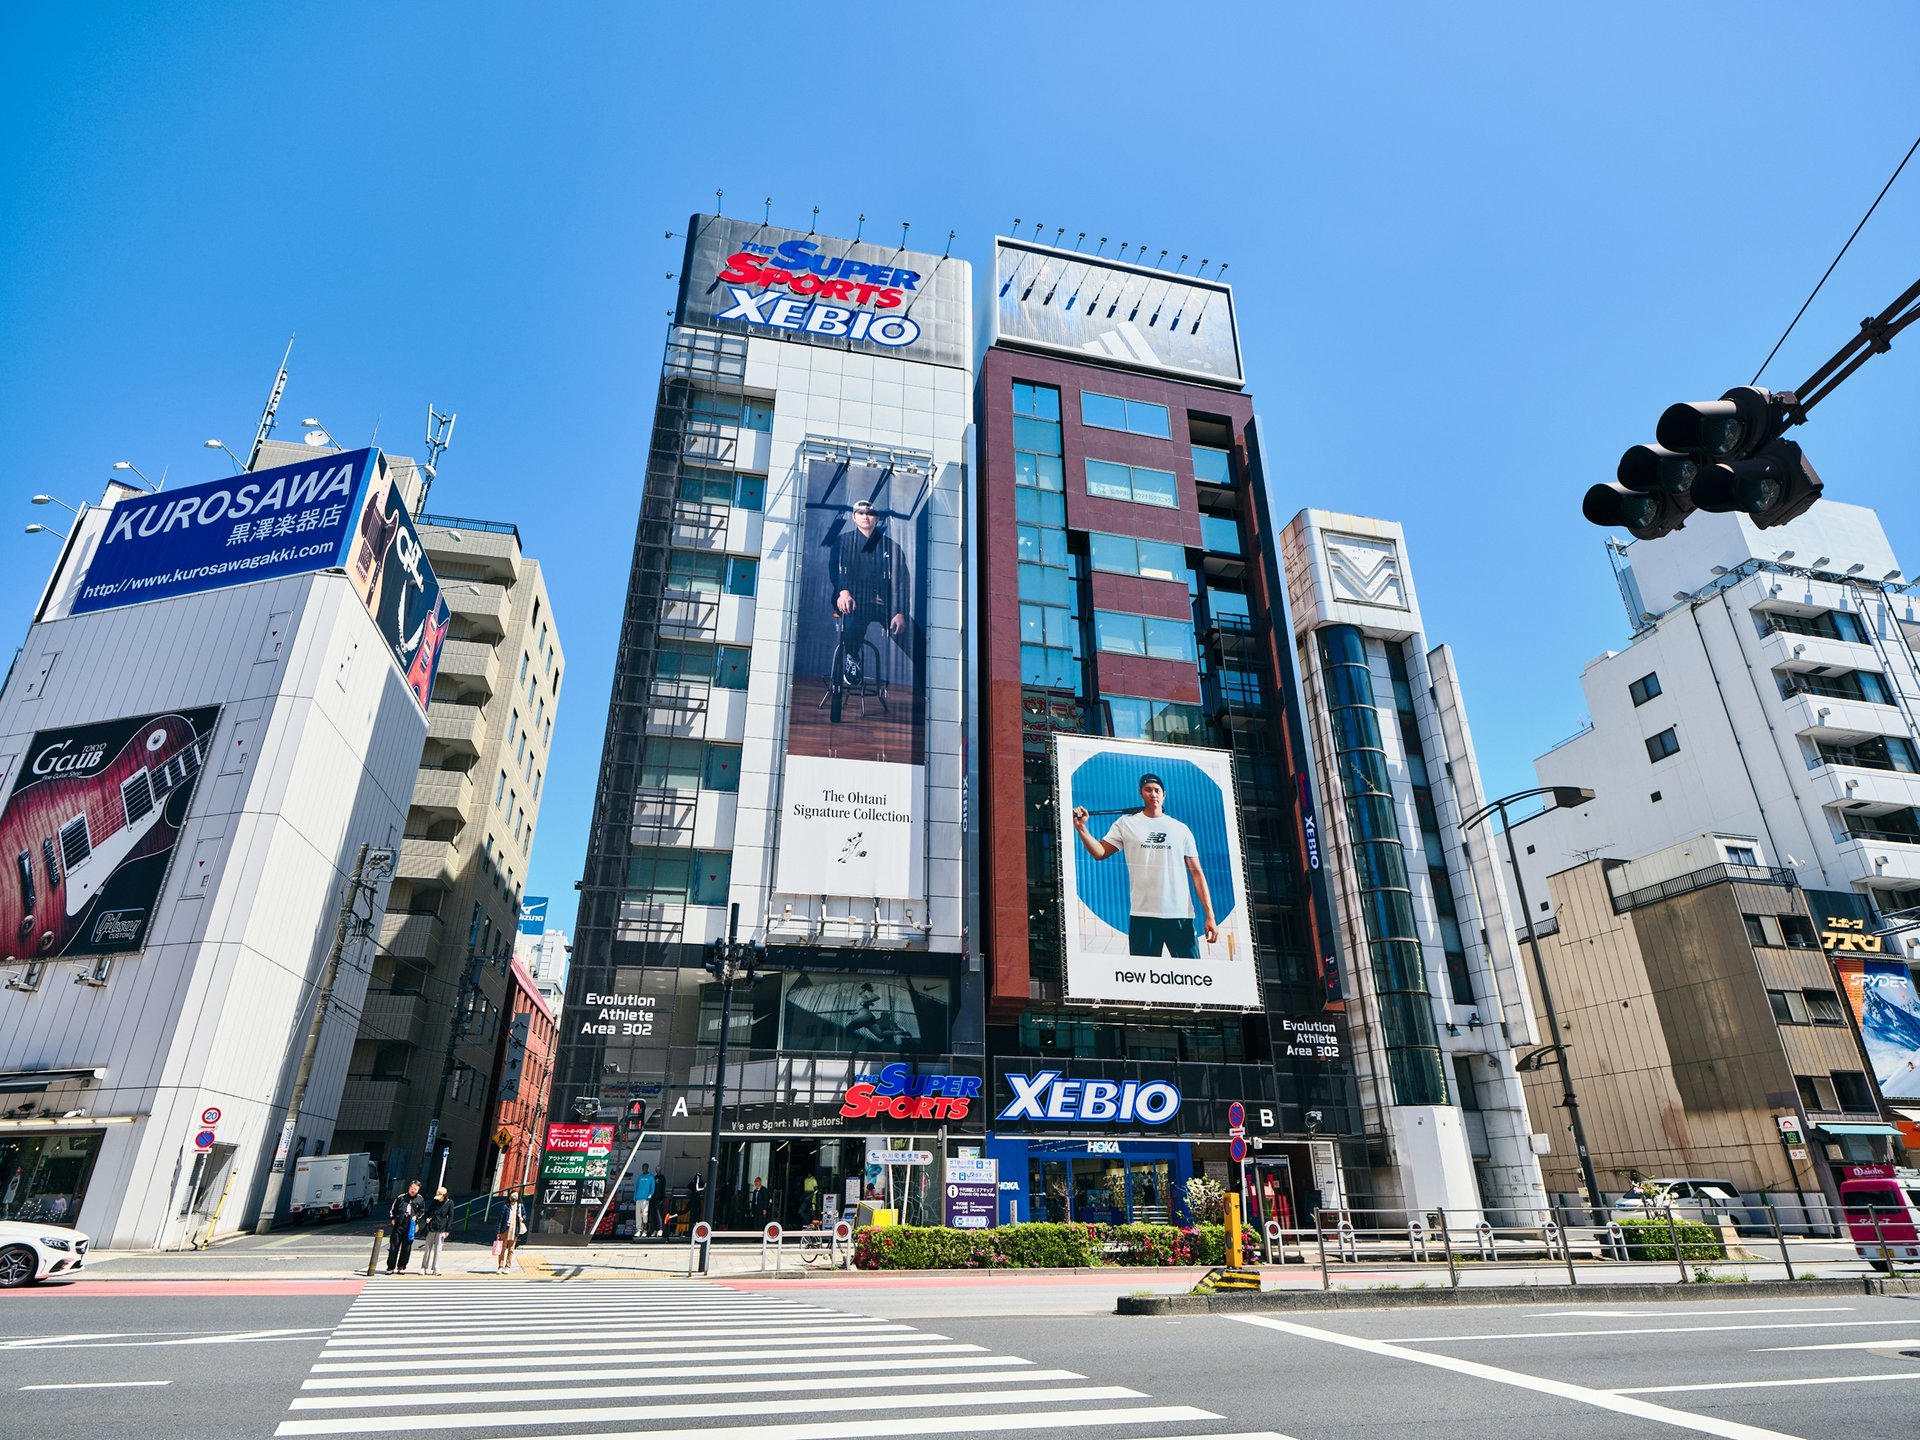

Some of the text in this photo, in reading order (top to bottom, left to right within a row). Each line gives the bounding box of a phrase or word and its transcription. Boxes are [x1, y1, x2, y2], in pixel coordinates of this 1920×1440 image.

[741, 240, 921, 291] THE SUPER
[717, 252, 903, 309] SPORTS
[715, 285, 921, 347] XEBIO
[105, 464, 354, 544] KUROSAWA
[226, 504, 346, 546] 黒澤楽器店
[83, 542, 334, 598] http://www.kurosawagakki.com
[82, 742, 107, 753] TOKYO
[823, 789, 887, 805] The Ohtani
[793, 804, 913, 823] Signature Collection.
[1304, 815, 1320, 870] XEBIO
[95, 913, 142, 942] Gibson
[1827, 917, 1864, 930] スポーツ
[1822, 931, 1882, 952] アスペン
[1115, 970, 1213, 987] new balance
[1850, 973, 1908, 989] SPYDER
[586, 993, 656, 1007] Evolution
[598, 1008, 654, 1022] Athlete
[581, 1022, 652, 1036] Area 302
[1283, 1020, 1336, 1033] Evolution
[1296, 1033, 1338, 1045] Athlete
[1287, 1045, 1340, 1057] Area 302
[855, 1062, 983, 1098] THE SUPER
[839, 1084, 971, 1120] SPORTS
[995, 1070, 1182, 1126] XEBIO
[671, 1096, 689, 1117] A
[206, 1111, 218, 1120] 20
[732, 1120, 744, 1131] We
[746, 1121, 760, 1130] are
[793, 1115, 843, 1128] Navgators!
[1260, 1109, 1274, 1127] B
[549, 1138, 589, 1148] Victoria
[1087, 1140, 1121, 1153] HOKA
[544, 1165, 585, 1174] L-Breath
[998, 1181, 1020, 1190] HOKA
